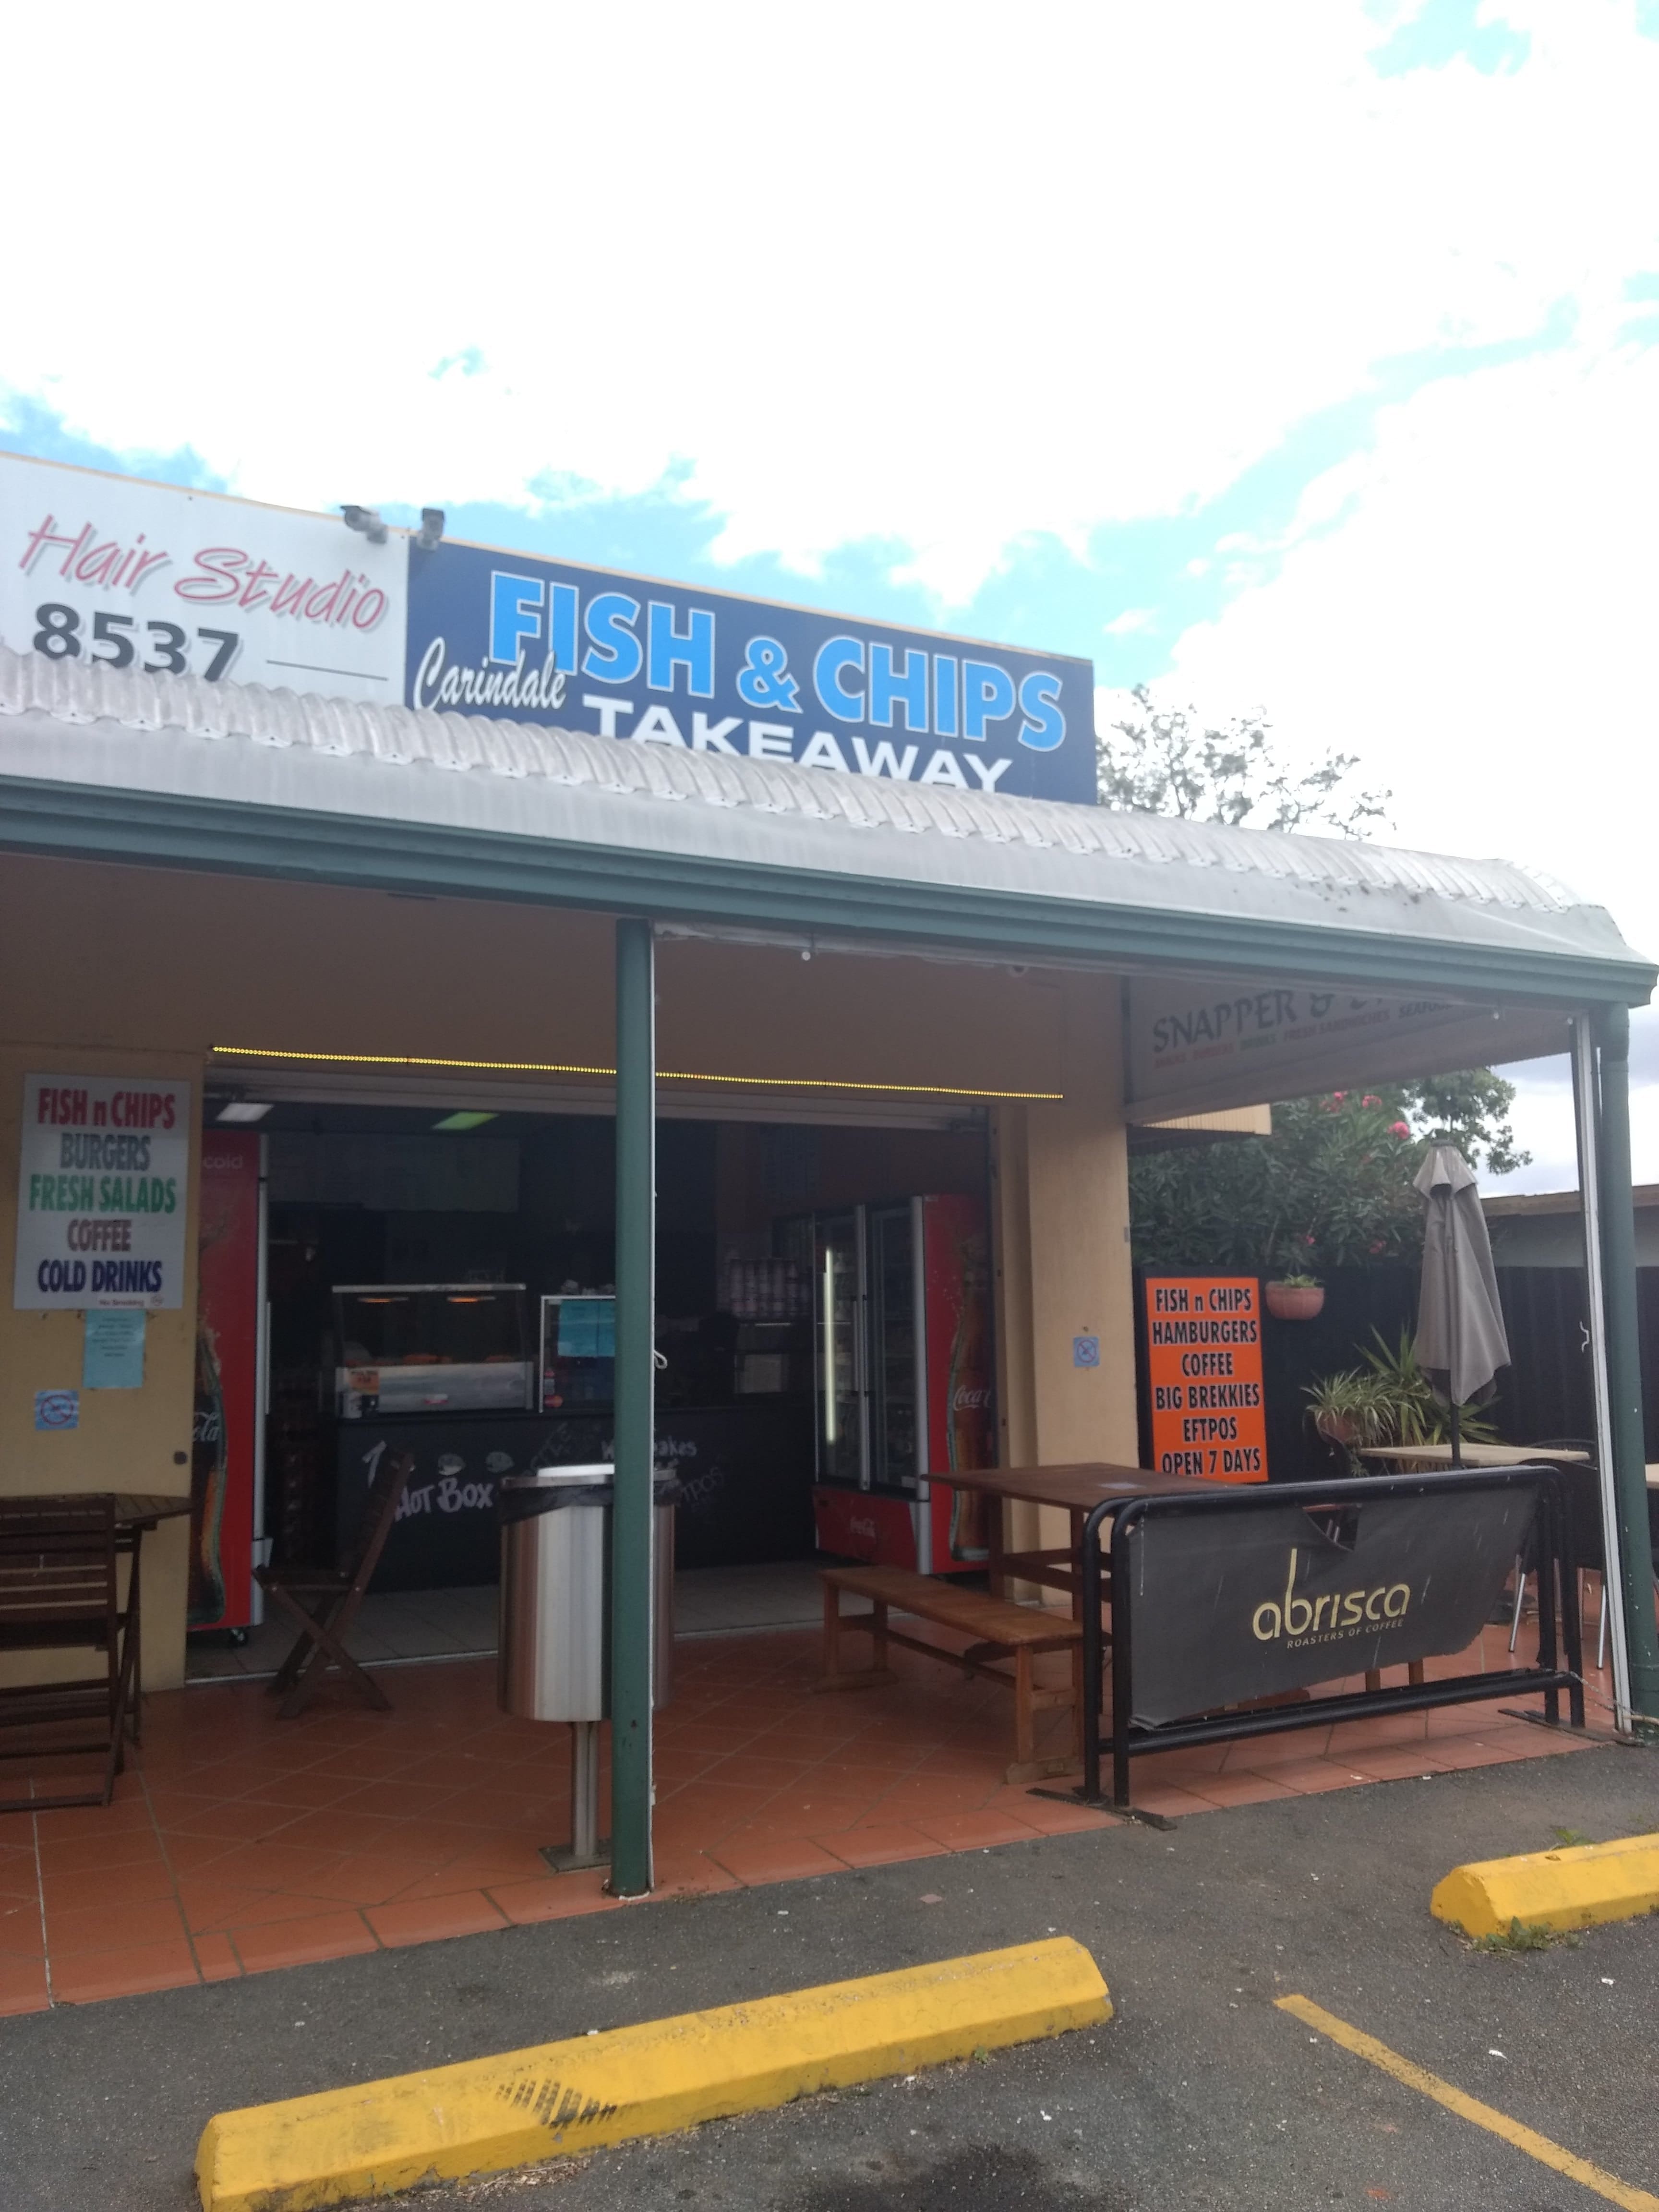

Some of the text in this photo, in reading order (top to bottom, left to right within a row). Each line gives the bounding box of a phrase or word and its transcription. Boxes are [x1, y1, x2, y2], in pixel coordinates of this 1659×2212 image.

[19, 514, 387, 630] Hair Studio
[33, 603, 240, 682] 8537
[489, 570, 1065, 752] FISH & CHIPS
[414, 637, 566, 709] Carindale
[582, 694, 1013, 793] TAKEAWAY
[1153, 990, 1298, 1053] SNAPPER
[37, 1088, 176, 1129] FISH n CHIPS
[60, 1132, 150, 1171] BURGERS
[29, 1174, 176, 1213] FRESH SALADS
[68, 1219, 132, 1252] COFFEE
[38, 1260, 162, 1293] COLD DRINKS
[1155, 1288, 1251, 1312] FISH n CHIPS
[1153, 1321, 1257, 1345] HAMBURGERS
[1181, 1352, 1233, 1377] COFFEE
[1155, 1383, 1260, 1410] BIG BREKKIES
[1183, 1417, 1237, 1443] EFTPOS
[1162, 1448, 1261, 1475] OPEN 7 DAYS
[1252, 1548, 1411, 1640] abrisca
[1286, 1618, 1403, 1648] ROASTERS OF COFFEE
